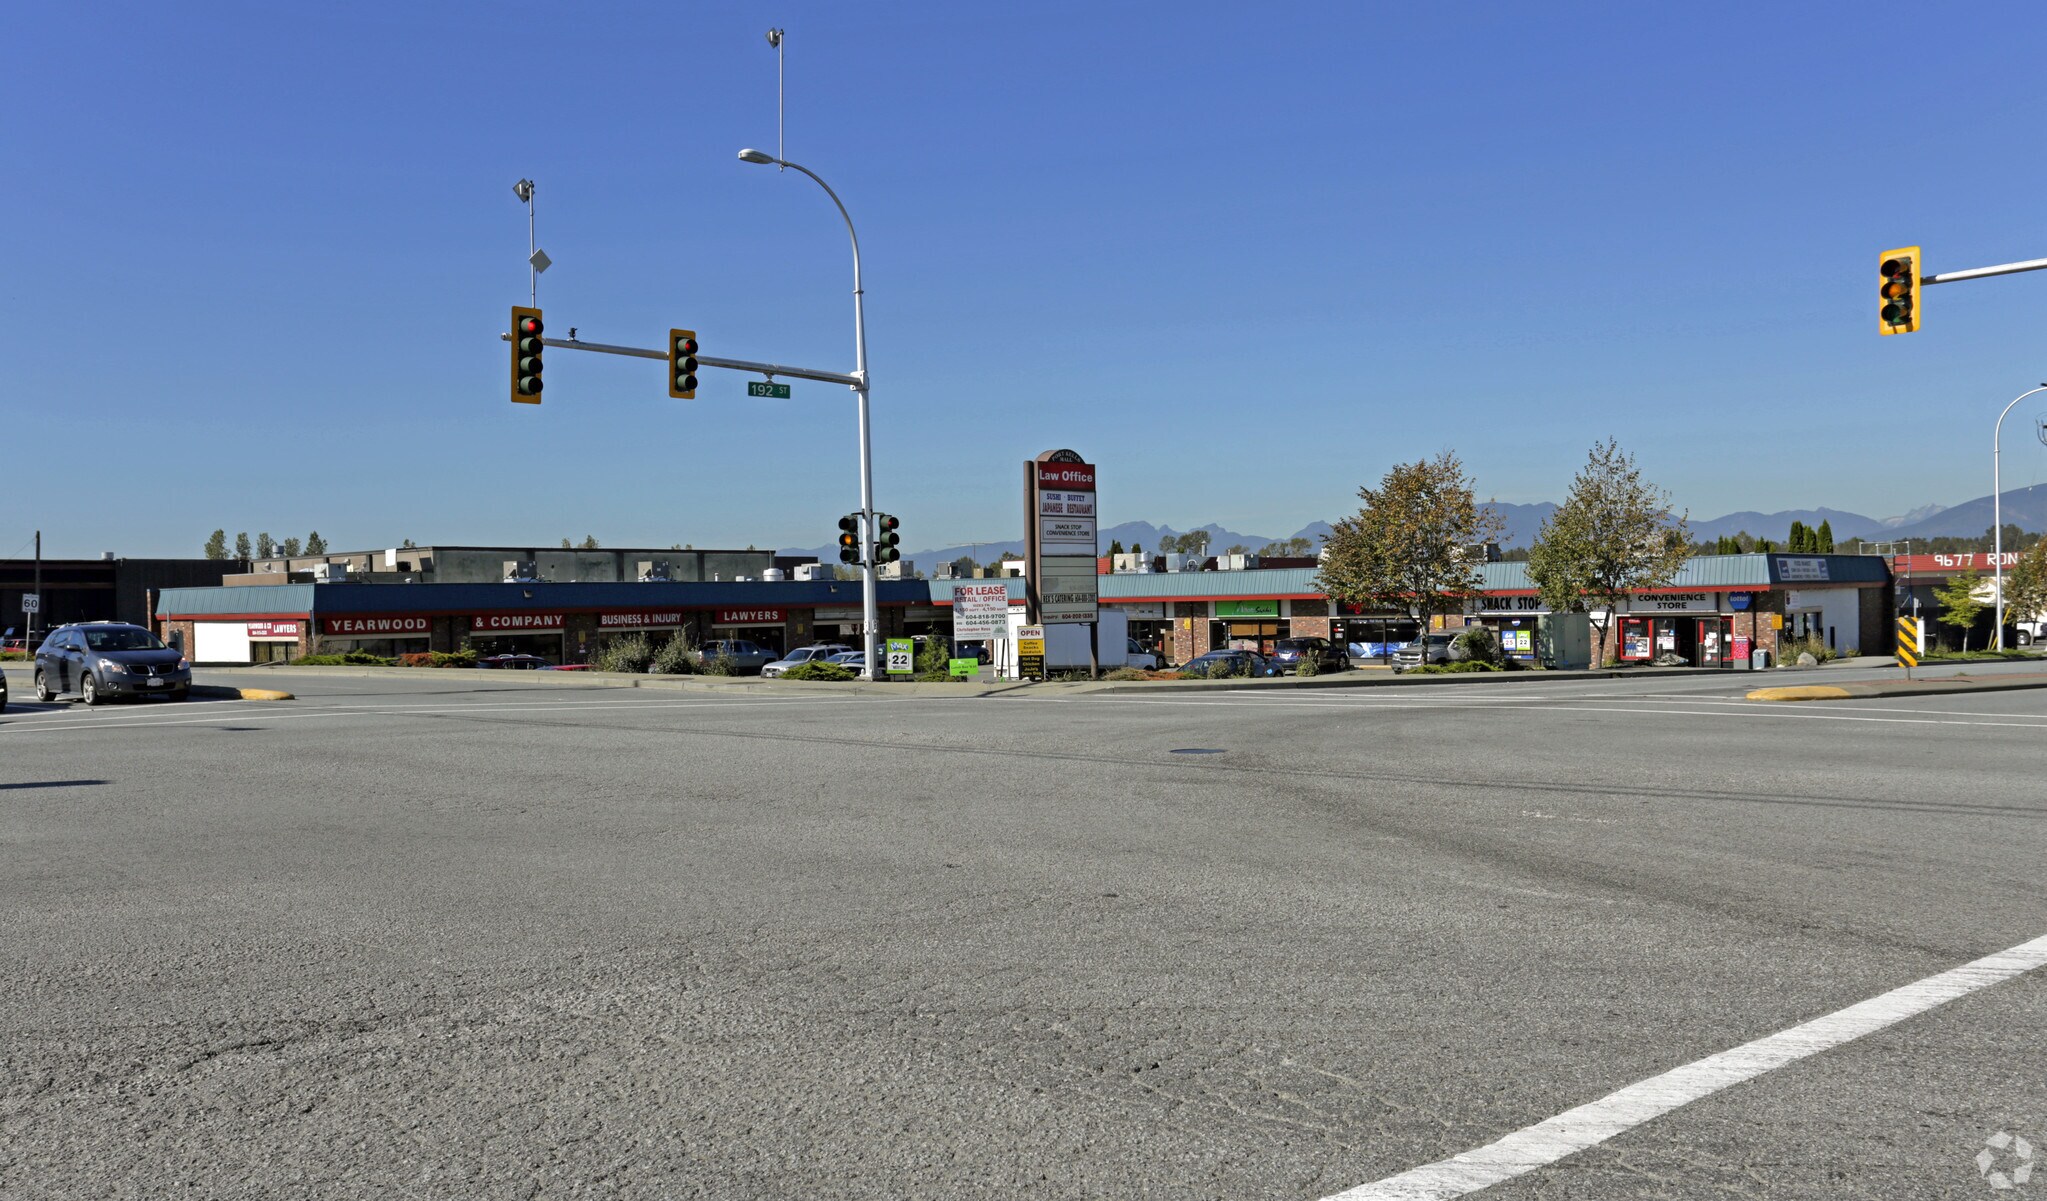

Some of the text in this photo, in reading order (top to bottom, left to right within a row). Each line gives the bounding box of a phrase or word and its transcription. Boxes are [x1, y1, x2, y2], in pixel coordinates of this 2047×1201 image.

[752, 384, 773, 396] 192
[1039, 470, 1092, 482] Law Office
[1934, 554, 1974, 566] 9677
[954, 586, 1006, 596] FOR LEASE
[24, 599, 38, 608] 60
[1482, 596, 1542, 610] SNACK STOP
[602, 613, 682, 624] BUSINESS & INJURY
[724, 610, 778, 621] LAWYERS
[332, 618, 427, 631] YEARWOOD
[475, 615, 562, 628] & COMPANY
[274, 624, 296, 633] LAWYERS
[892, 655, 908, 664] 22
